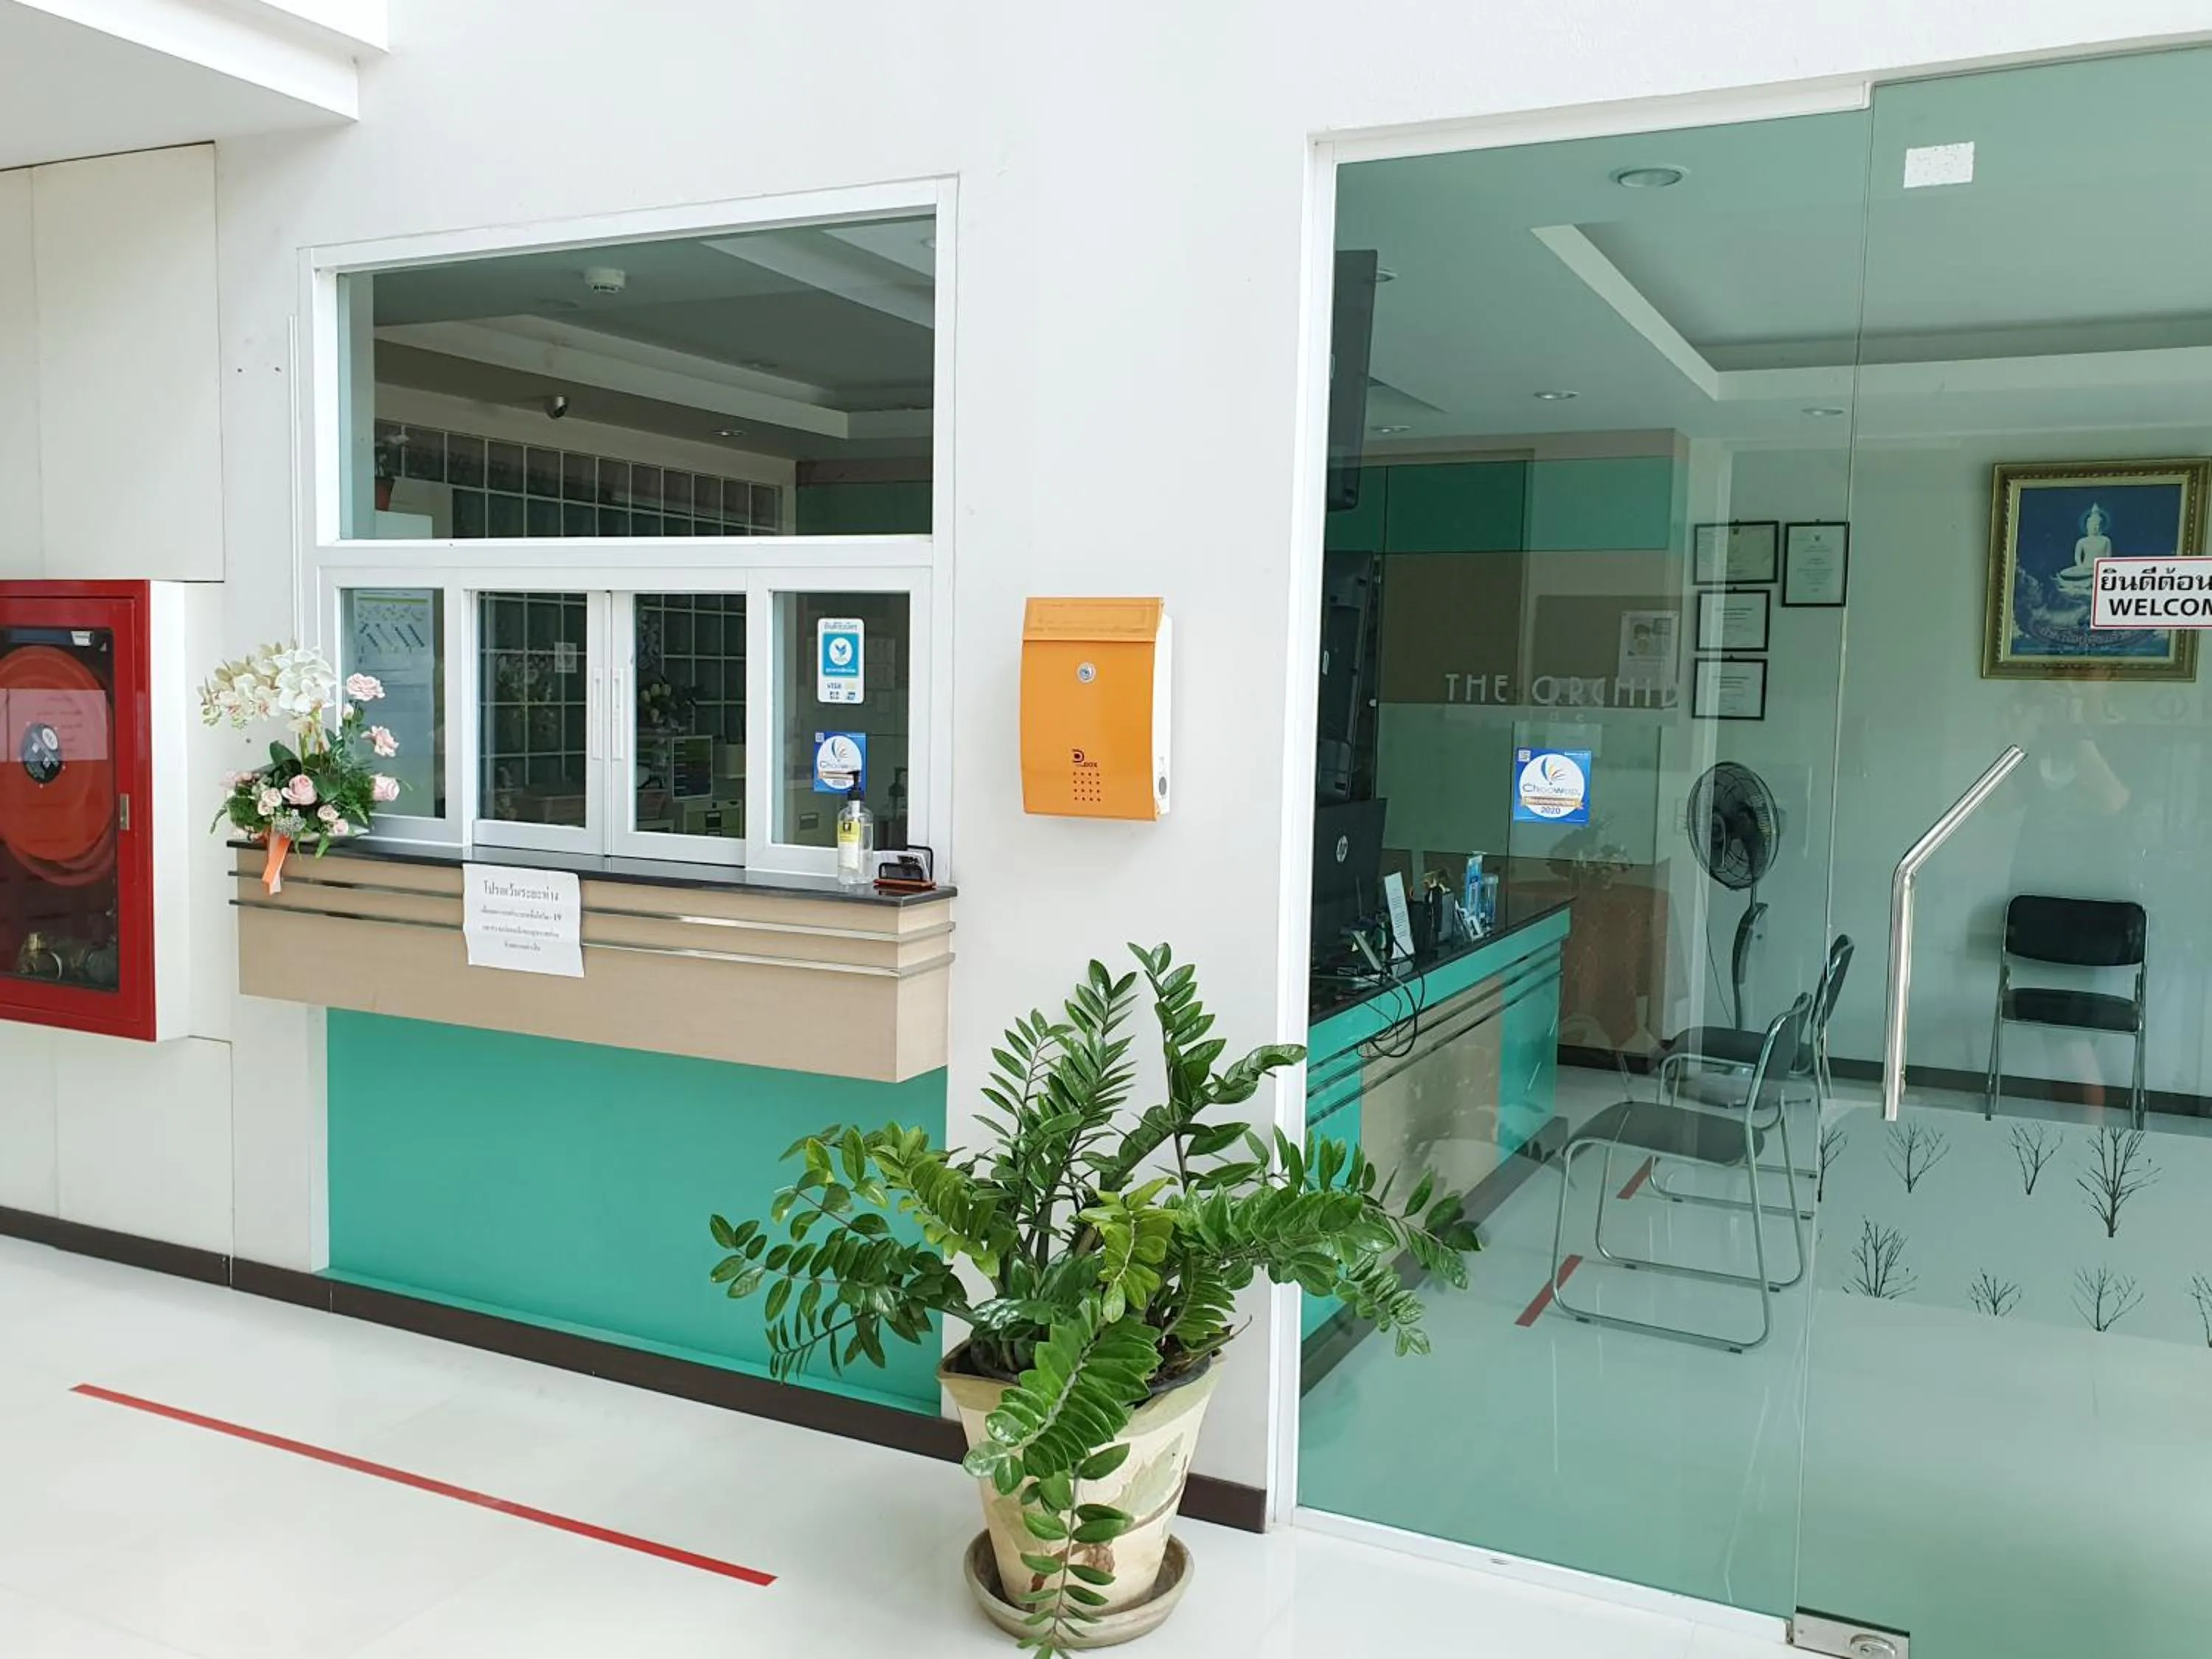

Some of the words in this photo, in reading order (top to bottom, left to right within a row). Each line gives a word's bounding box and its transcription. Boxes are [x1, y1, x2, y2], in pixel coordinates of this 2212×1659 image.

[1446, 674, 1508, 703] THE
[1532, 675, 1679, 707] ORCHID
[1540, 806, 1561, 815] 2020
